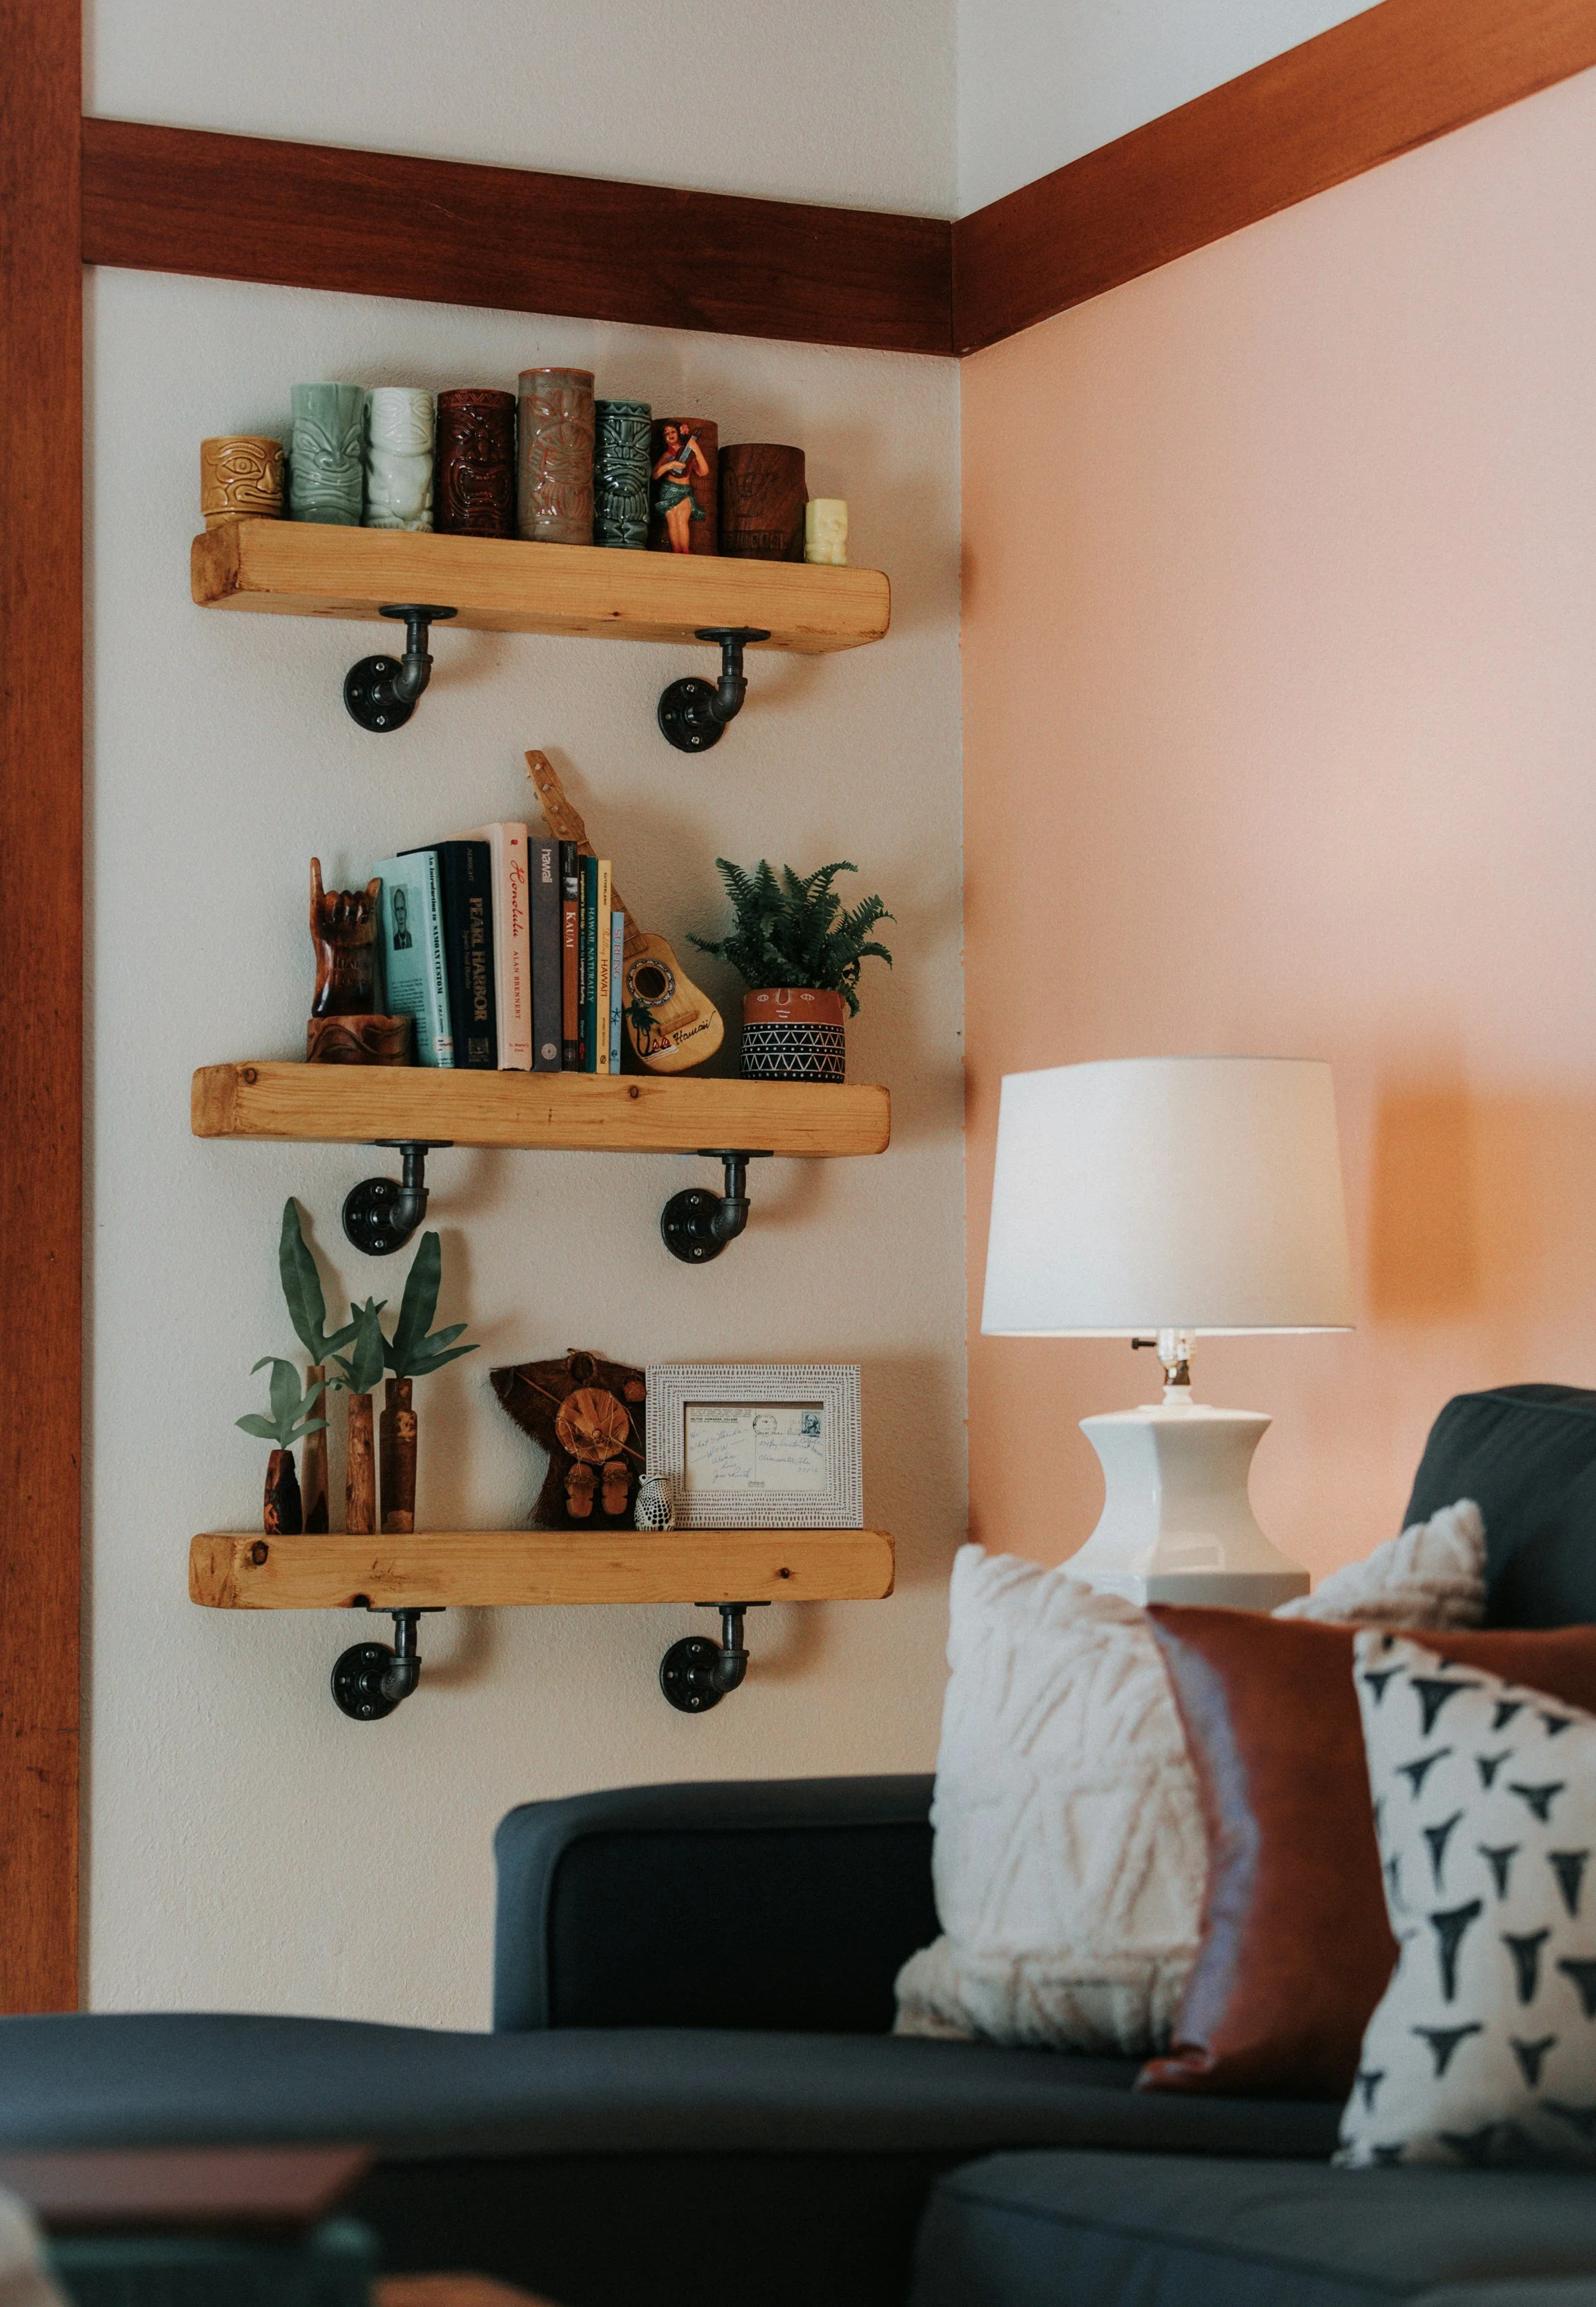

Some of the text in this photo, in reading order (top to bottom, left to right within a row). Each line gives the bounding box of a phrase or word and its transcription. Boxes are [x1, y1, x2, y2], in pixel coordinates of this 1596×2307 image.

[541, 848, 552, 883] hawaii
[510, 861, 525, 938] Honolulu
[565, 910, 575, 948] KAUAI
[470, 897, 488, 1021] PEARL HARBOR
[613, 928, 621, 978] SURFING
[673, 1011, 716, 1045] Hawaii
